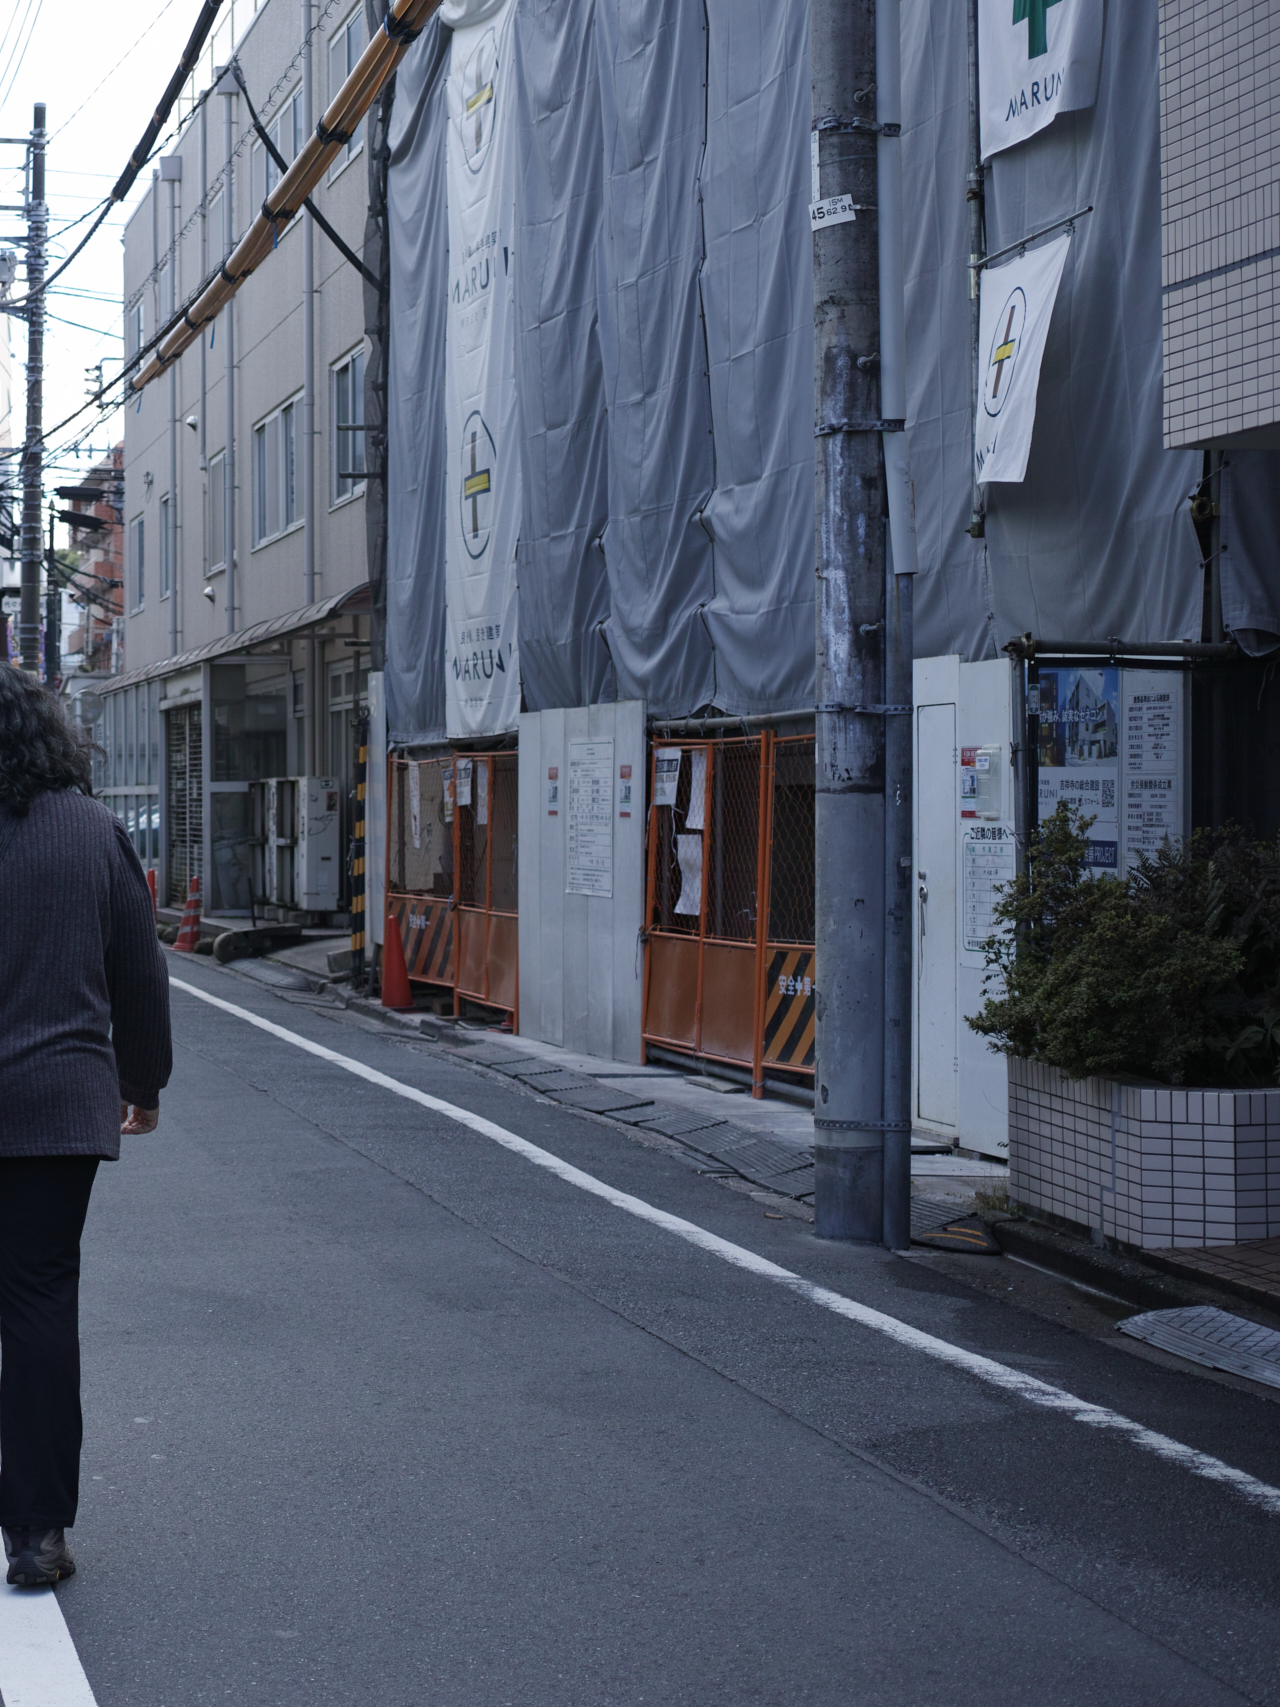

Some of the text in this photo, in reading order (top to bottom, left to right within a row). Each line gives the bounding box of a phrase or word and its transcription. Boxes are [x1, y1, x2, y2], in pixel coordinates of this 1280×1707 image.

[828, 197, 844, 207] 15M
[812, 206, 825, 221] 45
[1060, 779, 1100, 791] 吉祥寺の総合建設
[1130, 779, 1172, 790] 労災保険関係成立票
[1038, 789, 1058, 799] RUNI
[969, 826, 1009, 841] ご近隣の皆様へ
[1094, 846, 1115, 863] PROJECT
